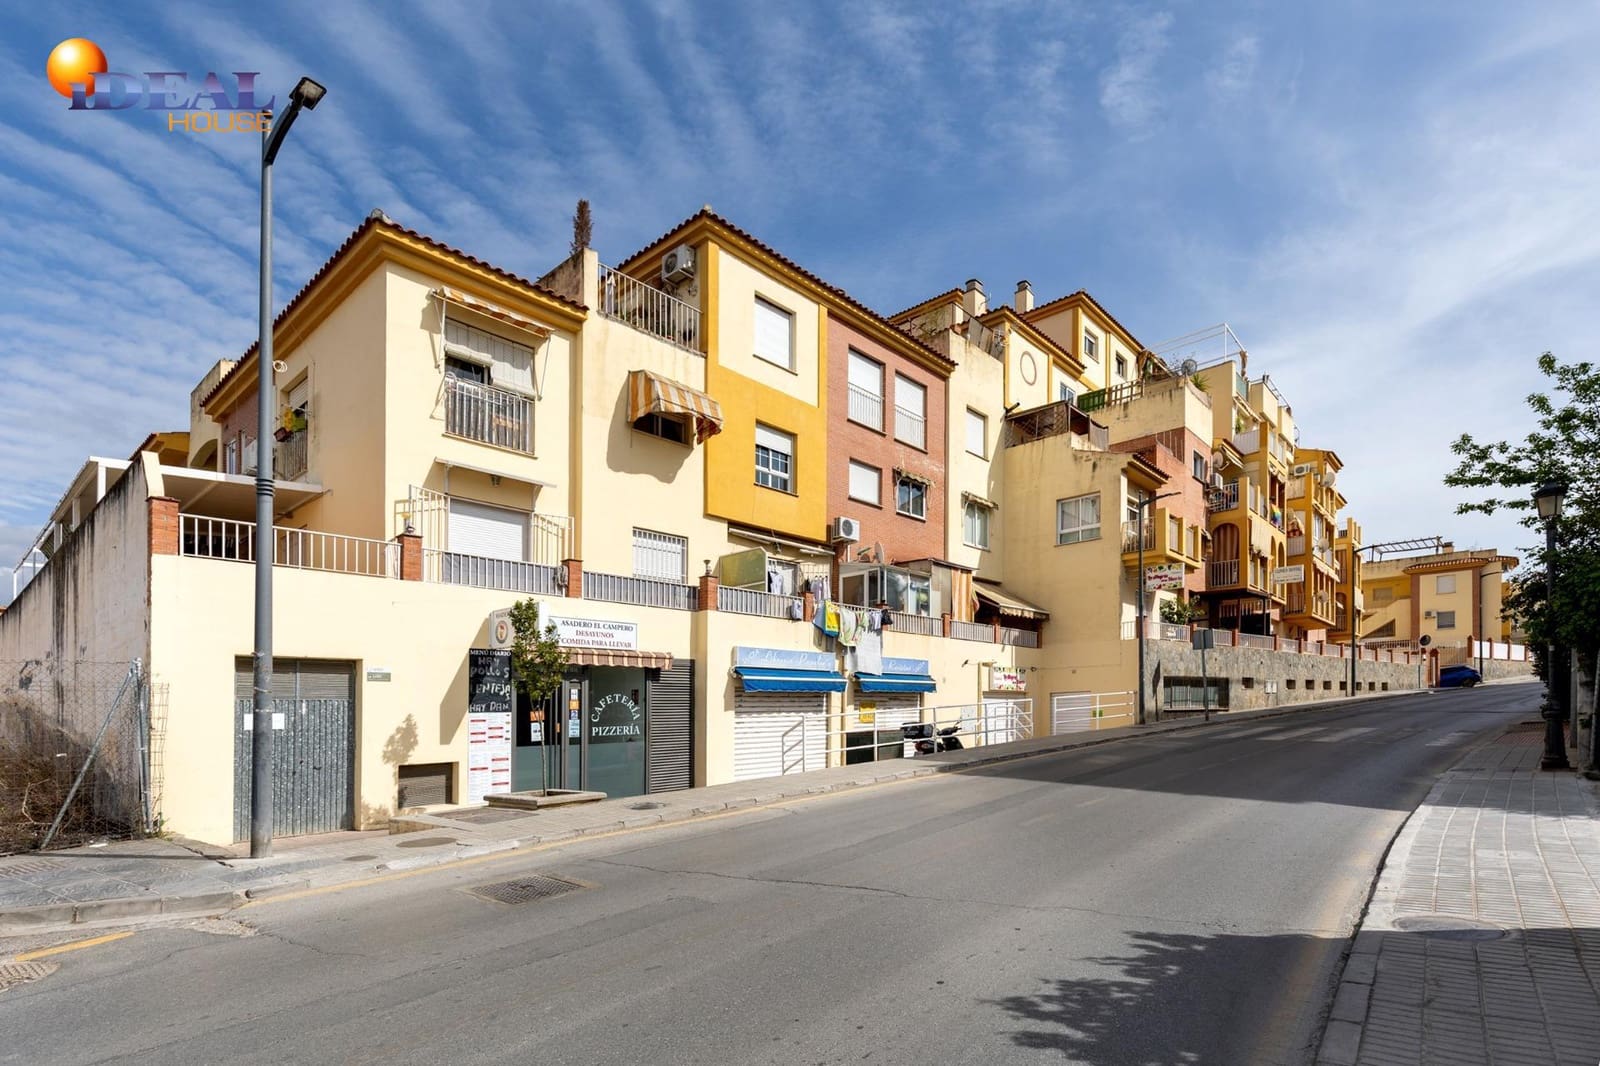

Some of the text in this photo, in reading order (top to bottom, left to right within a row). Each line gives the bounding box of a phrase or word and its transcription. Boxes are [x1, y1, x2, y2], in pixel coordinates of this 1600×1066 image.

[561, 619, 593, 629] ASADERO
[602, 623, 634, 632] CAMPERO
[575, 629, 615, 639] DESAYUNOS
[561, 637, 632, 648] COMIDA PARA LLEVAR
[591, 693, 641, 722] CAFETERÍA
[591, 723, 640, 736] PIZZERÍA
